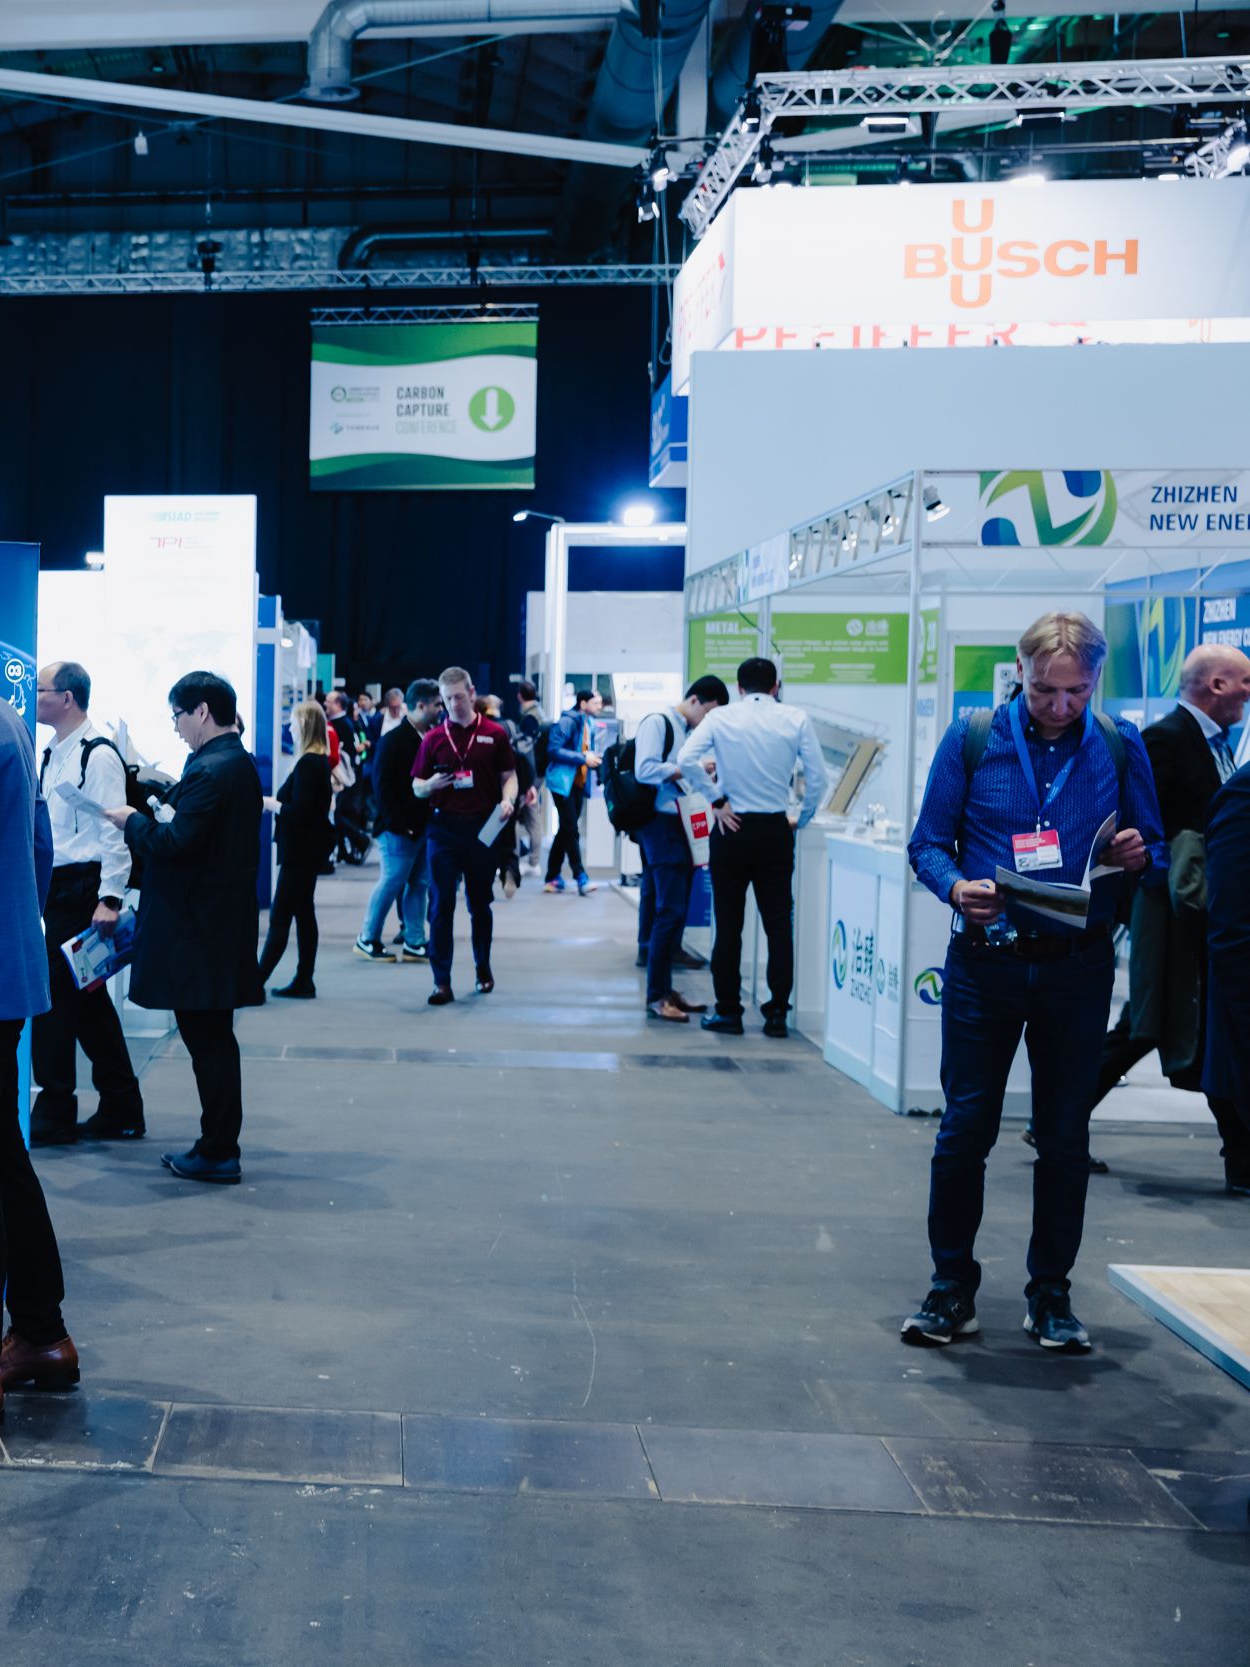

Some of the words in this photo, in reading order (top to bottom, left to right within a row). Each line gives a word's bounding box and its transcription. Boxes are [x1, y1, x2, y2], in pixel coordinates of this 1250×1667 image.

[903, 237, 1139, 280] BUSCH
[396, 386, 445, 400] CARBON
[396, 403, 450, 417] CAPTURE
[1151, 486, 1237, 503] ZHIZHEN
[1150, 514, 1199, 531] NEW
[1206, 514, 1250, 531] ENE
